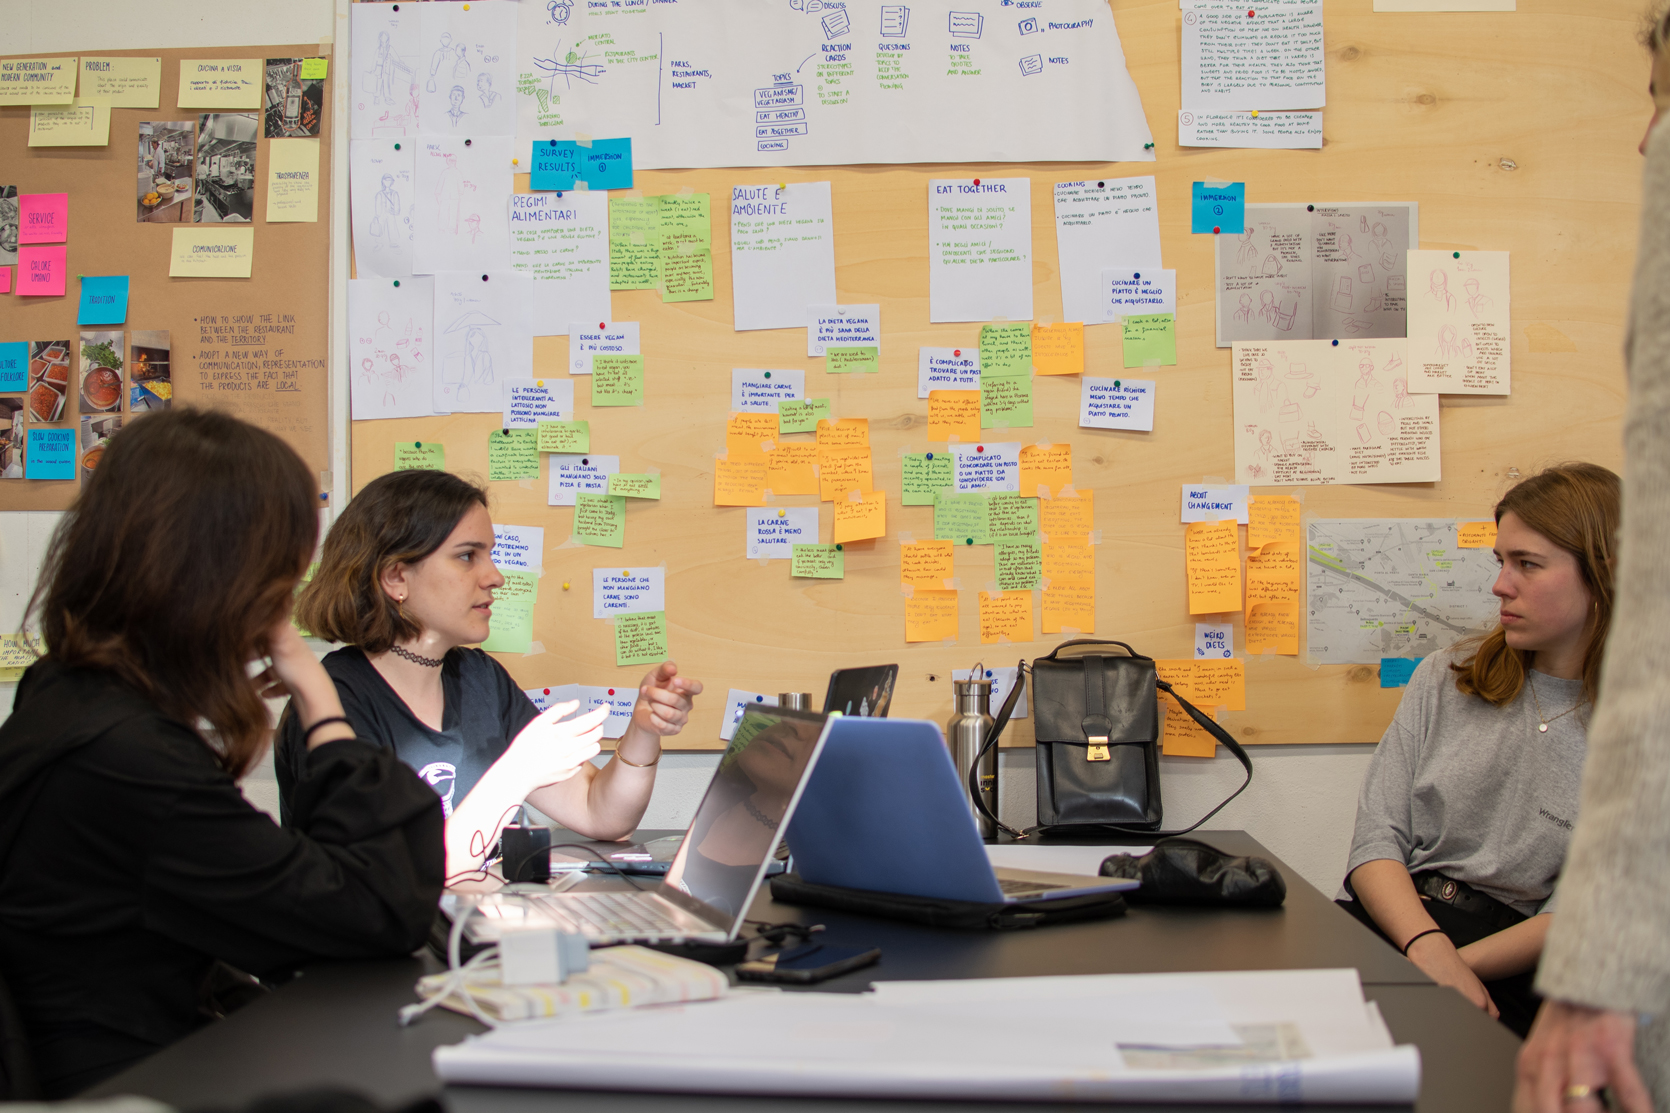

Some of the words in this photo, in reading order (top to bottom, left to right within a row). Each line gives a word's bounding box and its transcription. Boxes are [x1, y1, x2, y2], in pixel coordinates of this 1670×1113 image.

[950, 44, 970, 52] NOTES
[3, 62, 14, 71] NEW
[16, 61, 47, 71] GENERATION
[197, 64, 218, 72] CUCINA
[1, 72, 20, 82] MODERN
[23, 72, 54, 82] COMMUNITY
[540, 149, 574, 158] SURVEY
[539, 162, 575, 172] RESULTS
[936, 186, 952, 194] EAT
[957, 184, 1007, 194] TOGETHER
[733, 188, 768, 201] SALUTE
[513, 196, 547, 208] REGIMI
[733, 202, 787, 216] AMBIENTE
[28, 212, 55, 225] SERVICE
[512, 210, 576, 221] ALIMENTARI
[192, 244, 238, 254] COMUNICAZIONE
[30, 260, 52, 272] CALORE
[31, 272, 51, 283] UMANO
[88, 295, 116, 305] TRADITION
[200, 316, 217, 324] HOW
[220, 316, 229, 324] TO
[232, 315, 254, 324] SHOW
[259, 314, 273, 323] THE
[277, 314, 296, 324] LINK
[200, 326, 234, 334] BETWEEN
[238, 326, 250, 334] THE
[254, 325, 295, 334] RESTAURANT
[200, 336, 214, 344] AND
[216, 336, 228, 344] THE
[231, 335, 266, 344] TERRITORY
[199, 350, 220, 360] ADOPT
[224, 351, 230, 359] A
[232, 351, 249, 360] NEW
[252, 350, 268, 359] WAY
[274, 349, 284, 358] OF
[262, 359, 325, 370] REPRESENTATION
[1, 372, 25, 381] FOLKLORE
[199, 372, 208, 380] TO
[212, 372, 242, 380] EXPRESS
[246, 372, 259, 380] THE
[263, 371, 279, 380] FACT
[282, 370, 298, 380] THAT
[200, 382, 214, 390] THE
[218, 382, 252, 391] PRODUCTS
[257, 381, 270, 390] ARE
[32, 432, 45, 442] SLOW
[48, 432, 70, 442] COOKING
[39, 443, 70, 452] PREPARATION
[574, 464, 598, 472] ITALIANI
[1188, 502, 1233, 510] CHANGEMENT
[504, 534, 520, 543] CASO,
[1204, 630, 1224, 640] WEIRD
[4, 640, 17, 648] HOW
[1206, 638, 1225, 649] DIETS
